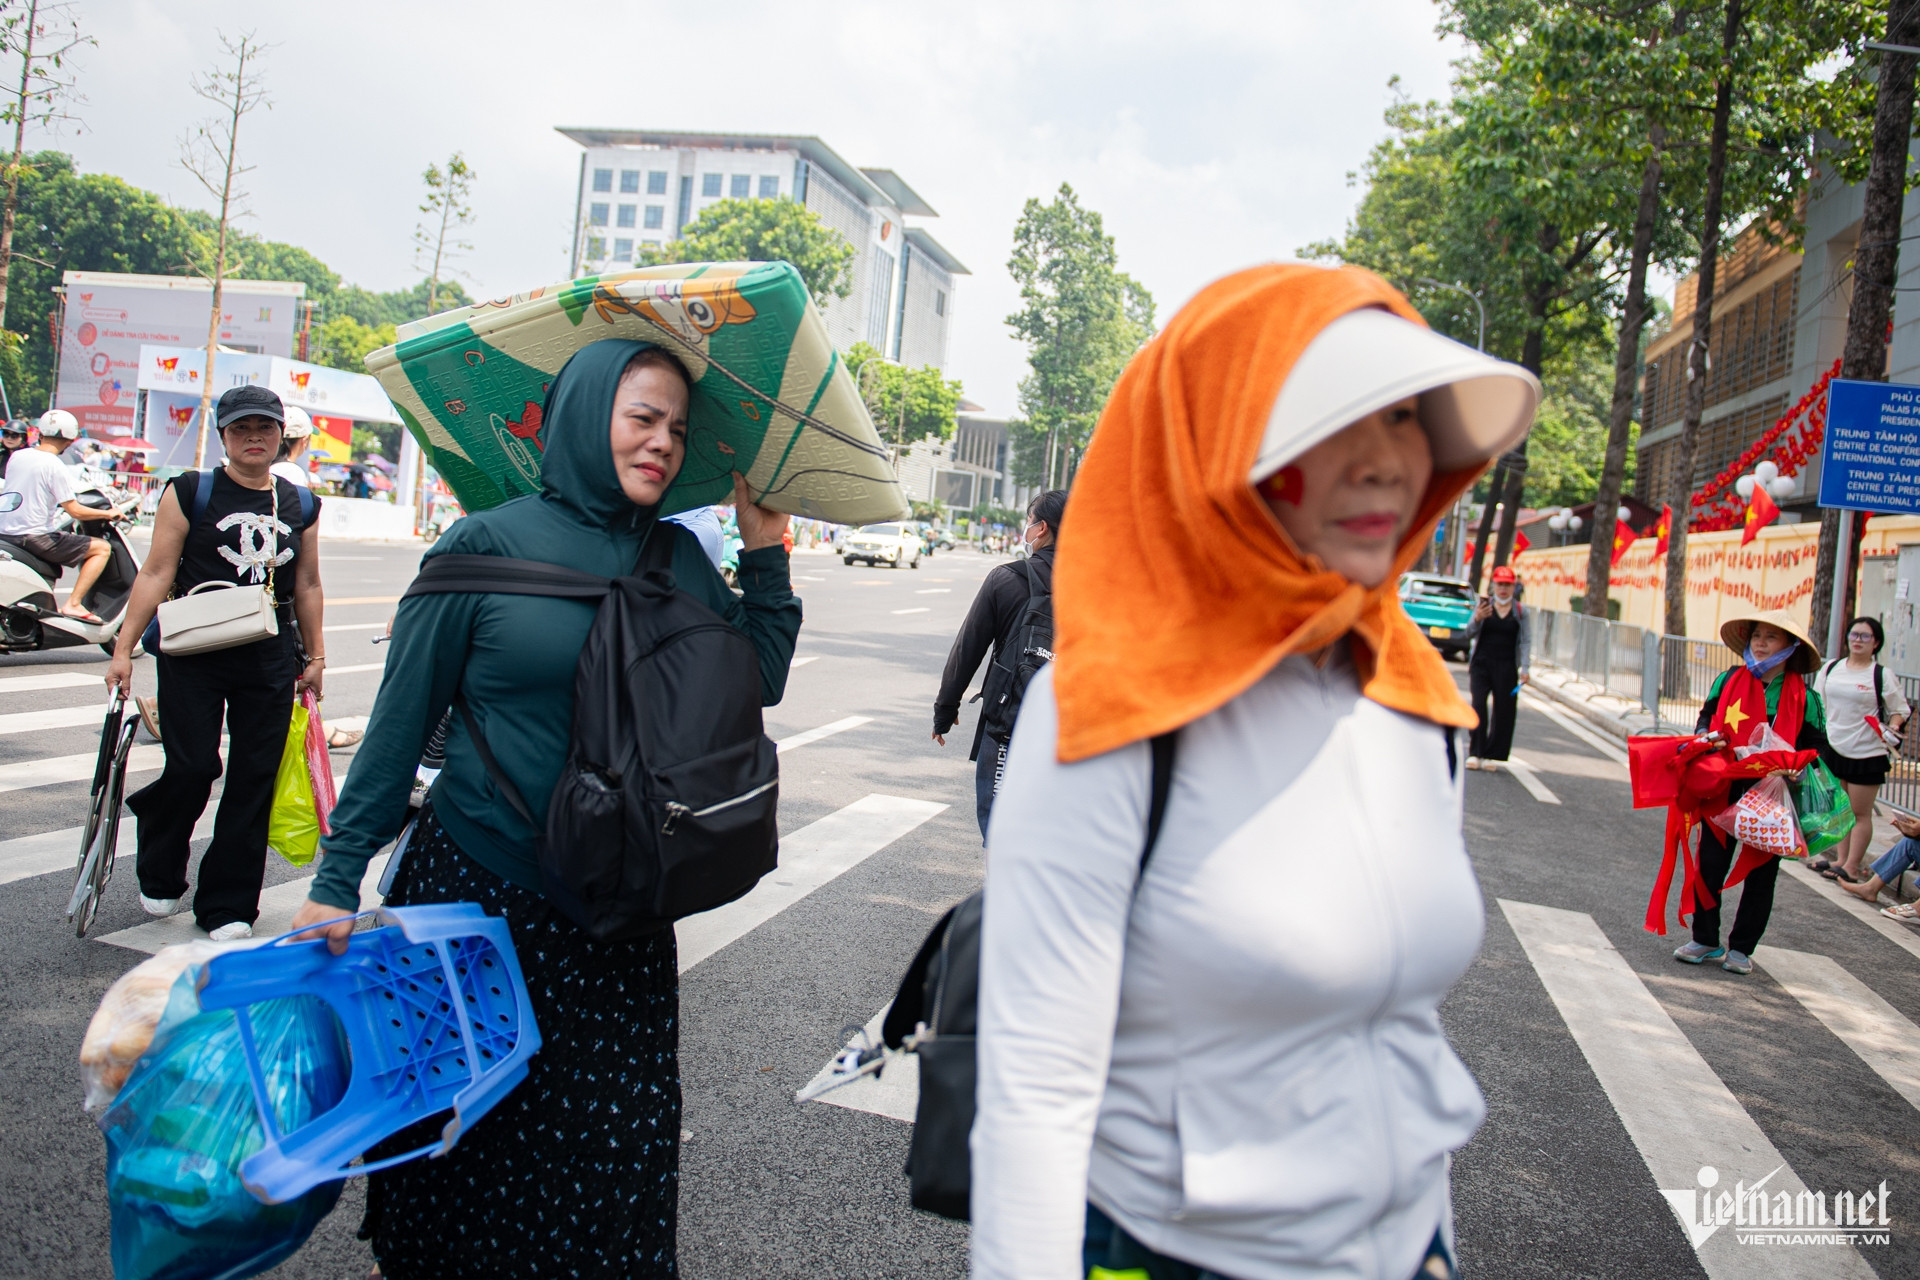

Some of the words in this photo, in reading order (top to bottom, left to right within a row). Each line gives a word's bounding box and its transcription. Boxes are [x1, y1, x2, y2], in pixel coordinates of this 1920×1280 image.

[1891, 390, 1913, 403] PHỦ
[1881, 403, 1910, 415] PALAIS
[1834, 427, 1870, 440] TRUNG
[1875, 430, 1897, 442] TÂM
[1900, 432, 1917, 445] HỘI
[1833, 440, 1866, 452] CENTRE
[1869, 442, 1880, 453] DE
[1832, 452, 1897, 466] INTERNATIONAL
[1849, 469, 1884, 481] TRUNG
[1889, 471, 1911, 484] TÂM
[1847, 480, 1880, 492] CENTRE
[1883, 483, 1895, 494] DE
[1846, 492, 1912, 507] INTERNATIONAL
